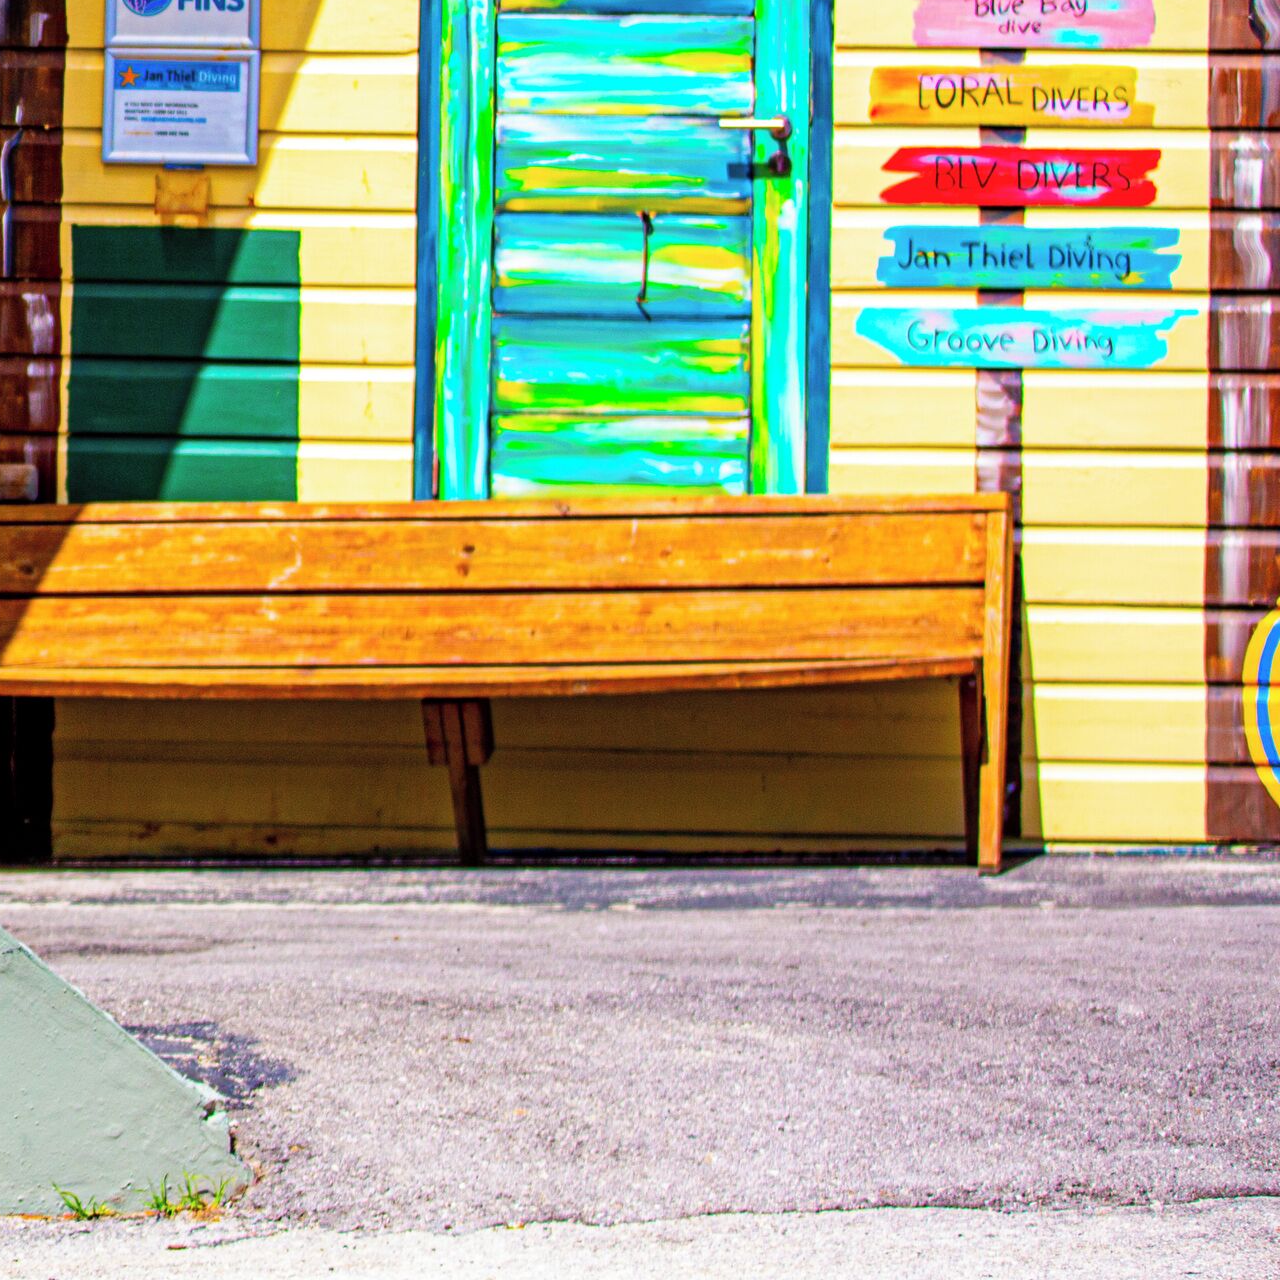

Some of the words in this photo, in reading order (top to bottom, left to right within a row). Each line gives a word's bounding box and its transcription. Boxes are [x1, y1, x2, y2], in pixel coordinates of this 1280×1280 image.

[998, 18, 1042, 36] dive
[143, 69, 163, 82] Jan
[167, 68, 196, 83] Thiel
[199, 70, 237, 85] Diving
[917, 73, 1024, 111] CORAL
[1032, 86, 1131, 113] DIVERS
[1017, 158, 1131, 192] DIVERS
[898, 238, 951, 270] Jan
[960, 240, 1035, 270] Thiel
[1048, 234, 1132, 280] Diving
[906, 320, 1015, 353] Groove
[1032, 327, 1114, 358] Diving
